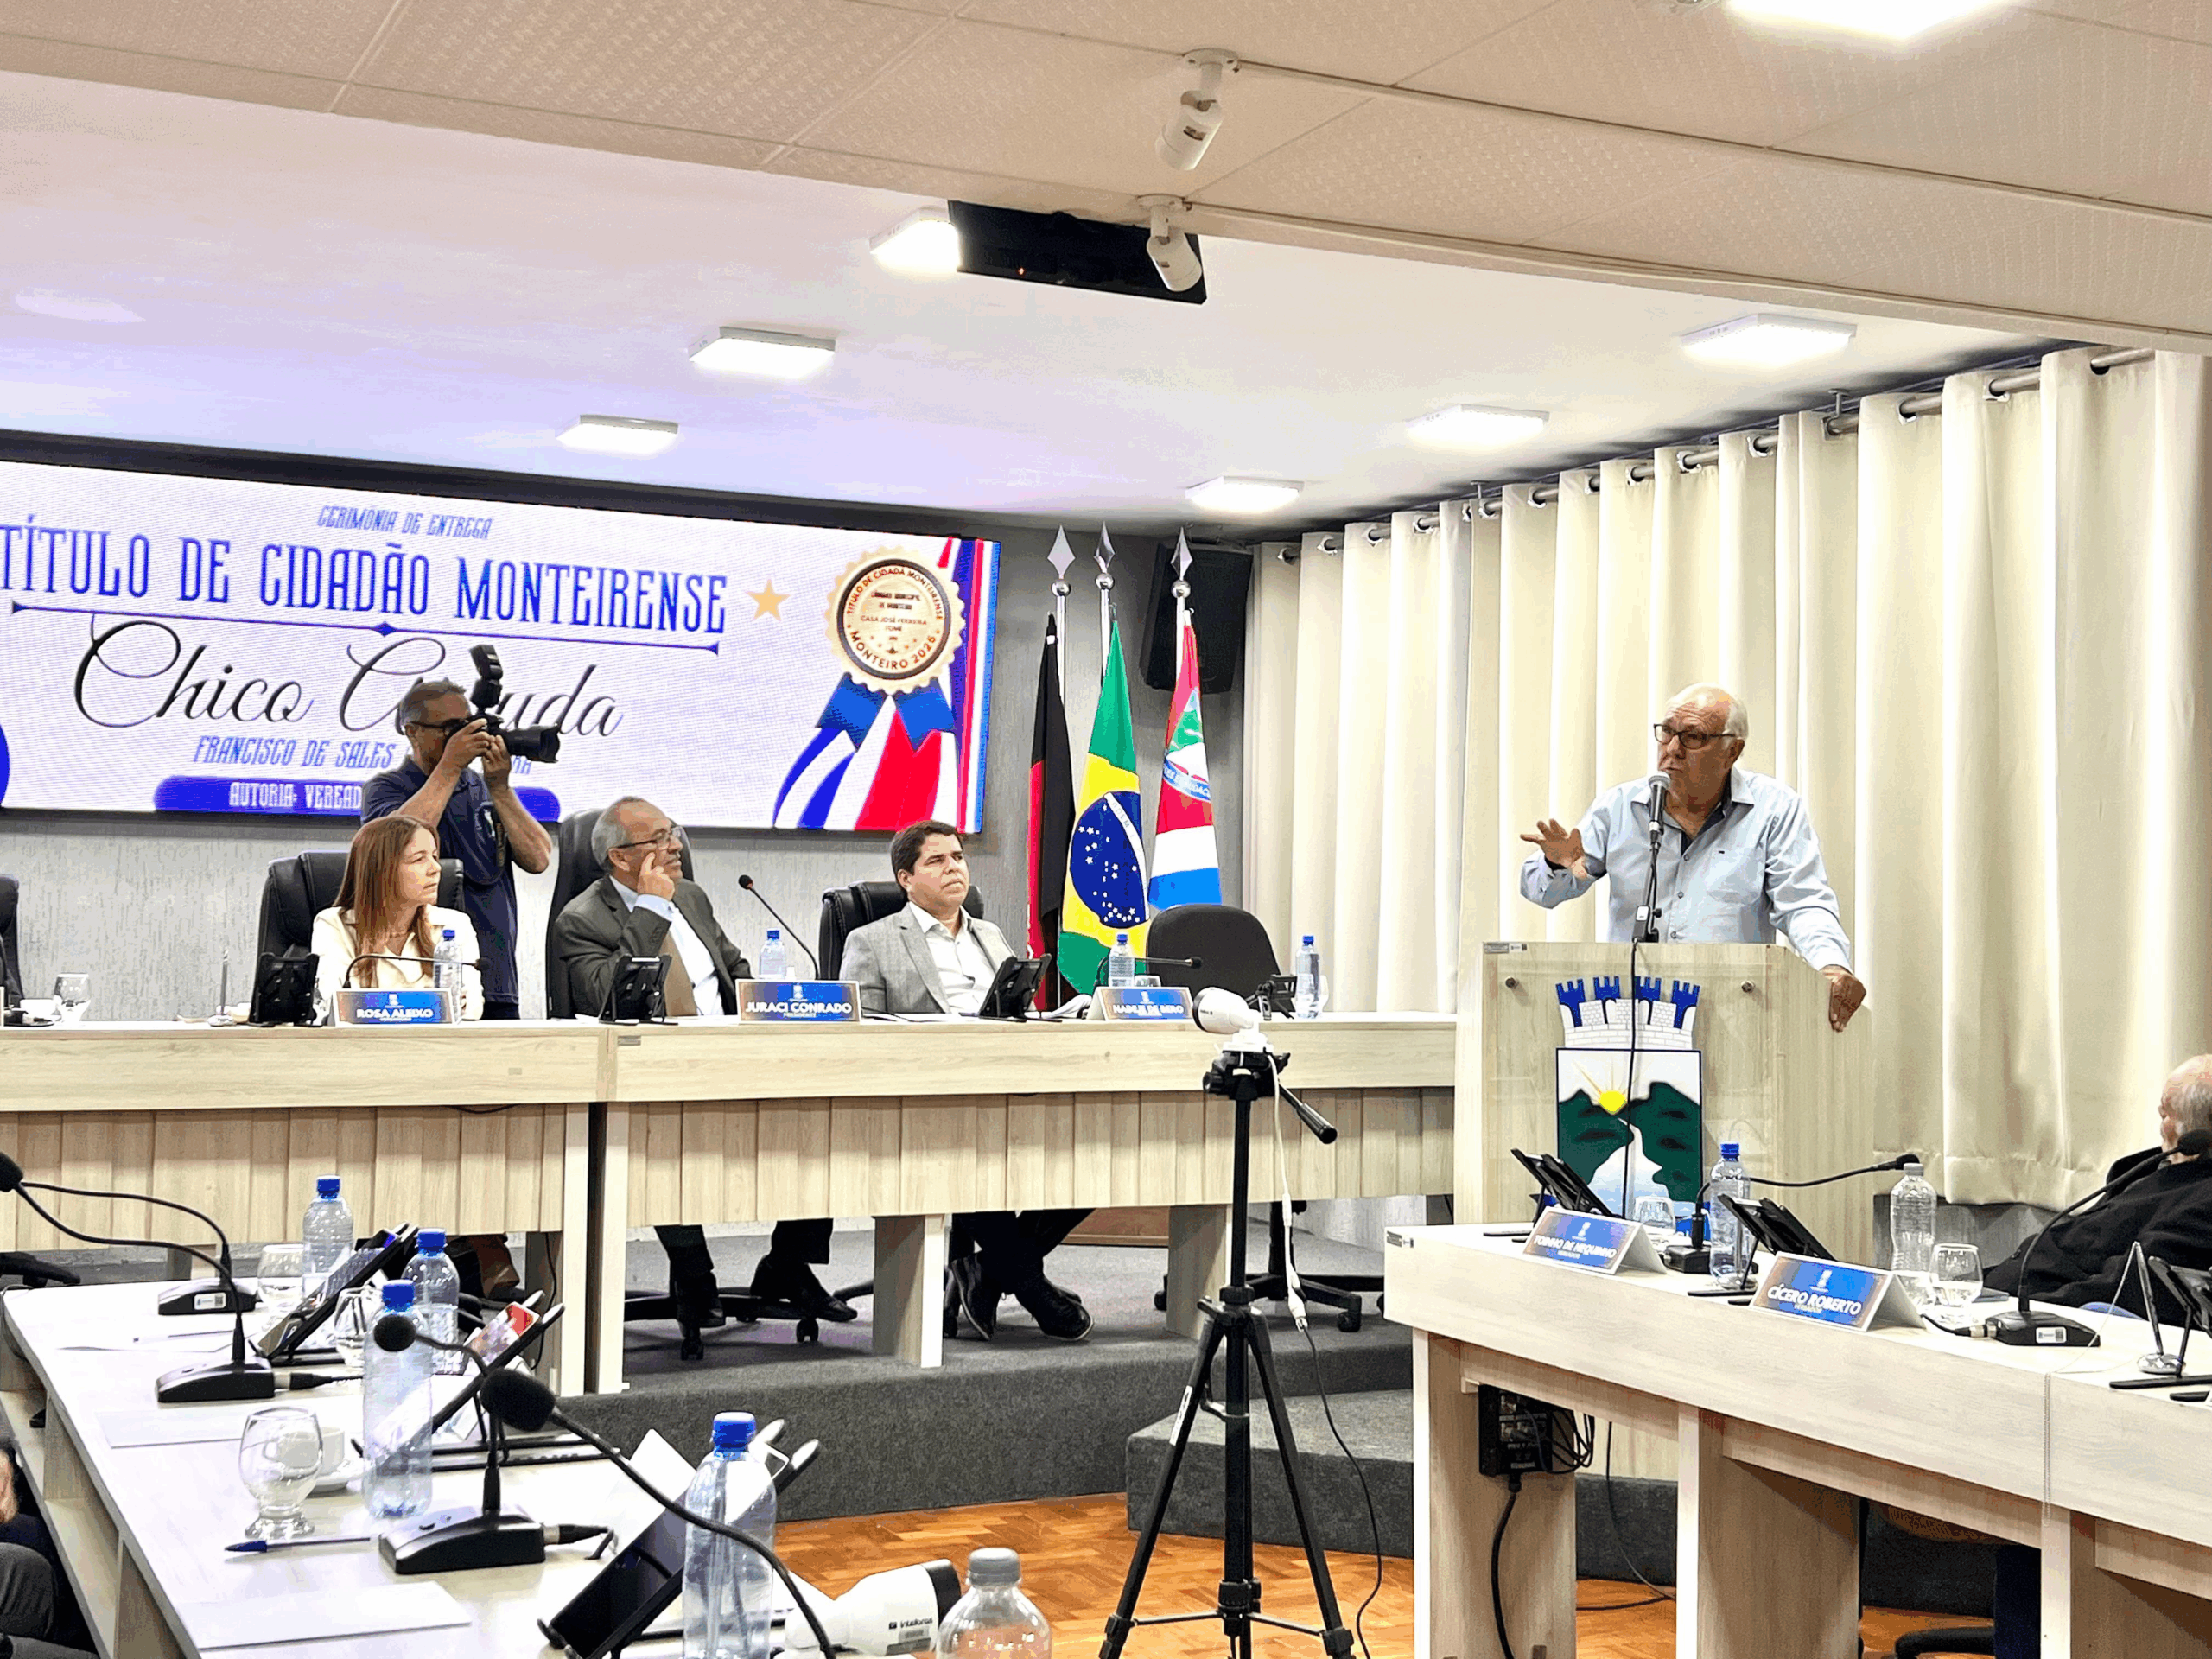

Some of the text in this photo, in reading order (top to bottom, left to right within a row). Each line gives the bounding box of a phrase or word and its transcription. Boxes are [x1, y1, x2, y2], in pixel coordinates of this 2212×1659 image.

[402, 512, 423, 534] DE
[426, 514, 493, 540] ENTREGA
[0, 514, 728, 635] TÍTULO DE CIDADÃO MONTEIRENSE
[851, 632, 908, 669] MONTEIRO
[74, 613, 314, 728] Chico
[193, 734, 397, 770] FRANCISCO DE SALES
[228, 781, 363, 810] AUTORIA: VEREAD
[356, 1008, 434, 1018] ROSA ALEIXO
[747, 1002, 852, 1013] JURACI CONRADO
[1564, 1241, 1576, 1250] DE
[1768, 1284, 1861, 1315] CÍCERO ROBERTO
